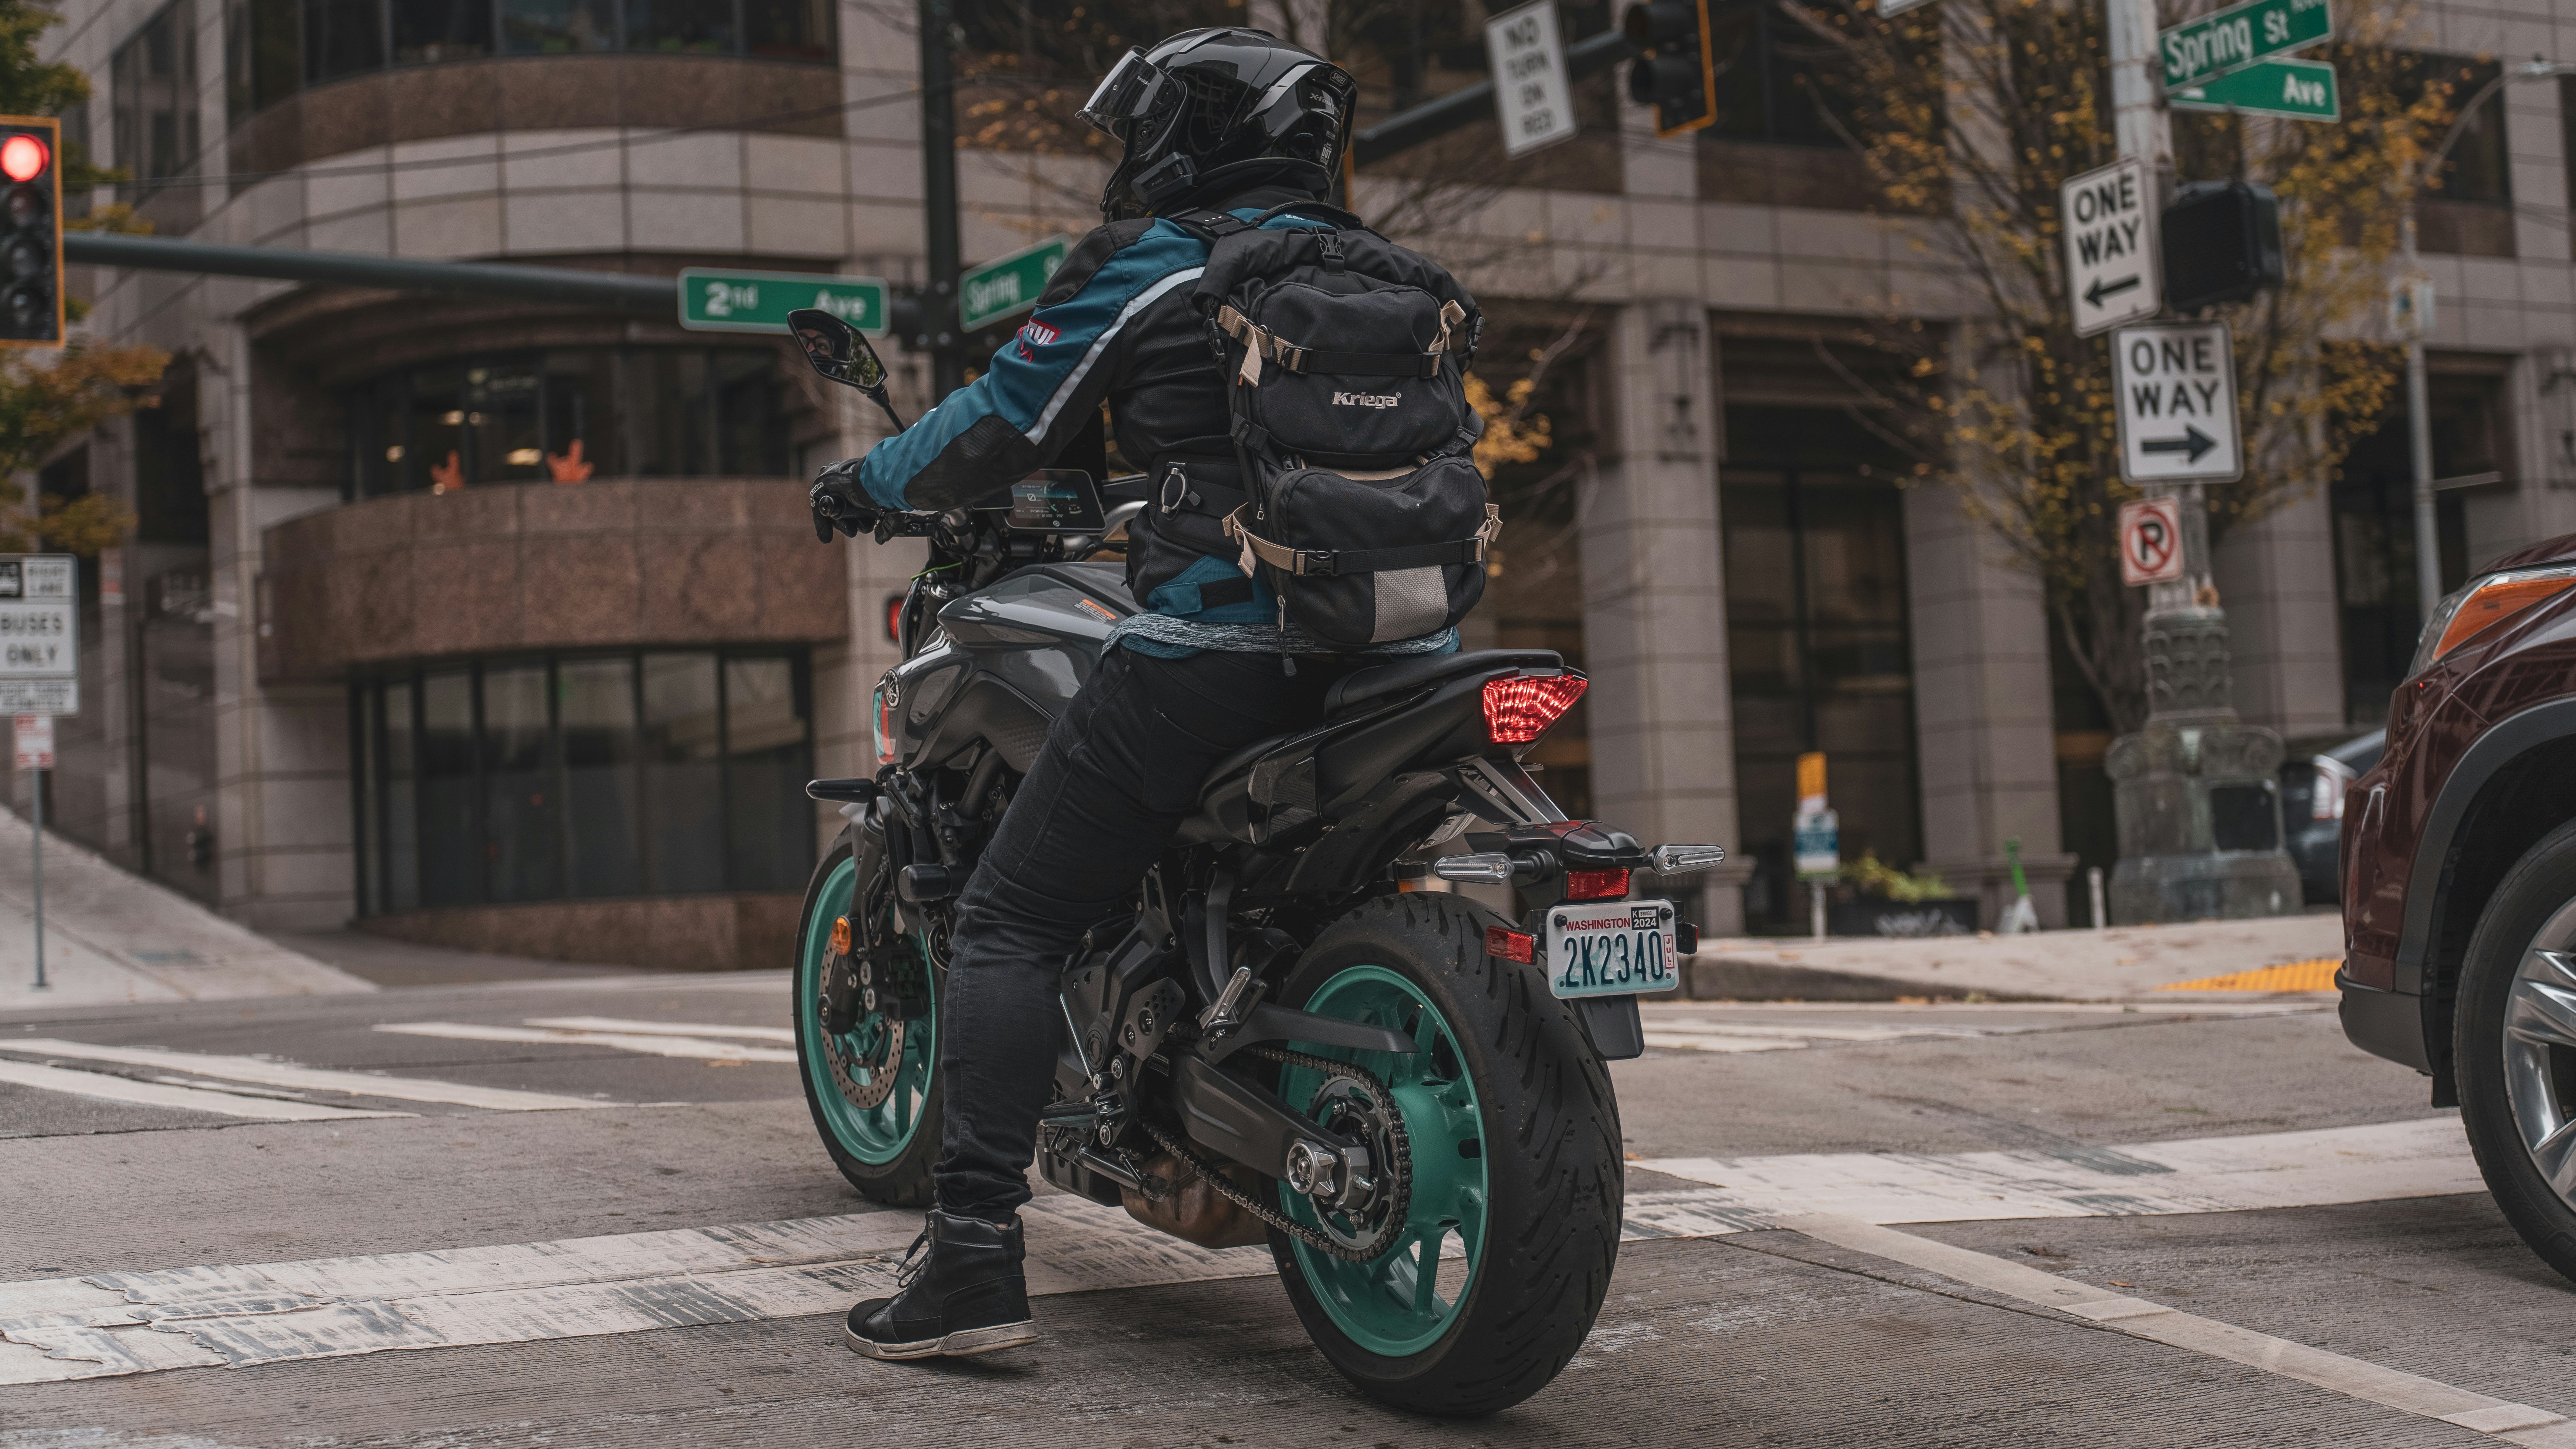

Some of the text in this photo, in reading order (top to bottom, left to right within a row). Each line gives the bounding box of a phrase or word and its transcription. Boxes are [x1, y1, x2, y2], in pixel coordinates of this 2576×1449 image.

[1505, 16, 1540, 47] NO
[2165, 10, 2290, 79] Spring St
[1332, 72, 1346, 84] SHOEI
[2284, 73, 2326, 107] Ave
[1321, 147, 1332, 160] DOT
[2074, 175, 2136, 222] ONE
[2077, 218, 2143, 269] WAY
[704, 281, 867, 321] 2nd Ave
[967, 272, 1020, 315] Spring
[2130, 337, 2216, 375] ONE
[2131, 381, 2221, 418] WAY
[1, 612, 64, 637] BUSES
[6, 643, 58, 667] ONLY
[1566, 917, 1631, 931] WASHINGTON
[1632, 910, 1638, 918] K
[1634, 918, 1657, 928] 2024
[1564, 931, 1664, 988] 2K2340
